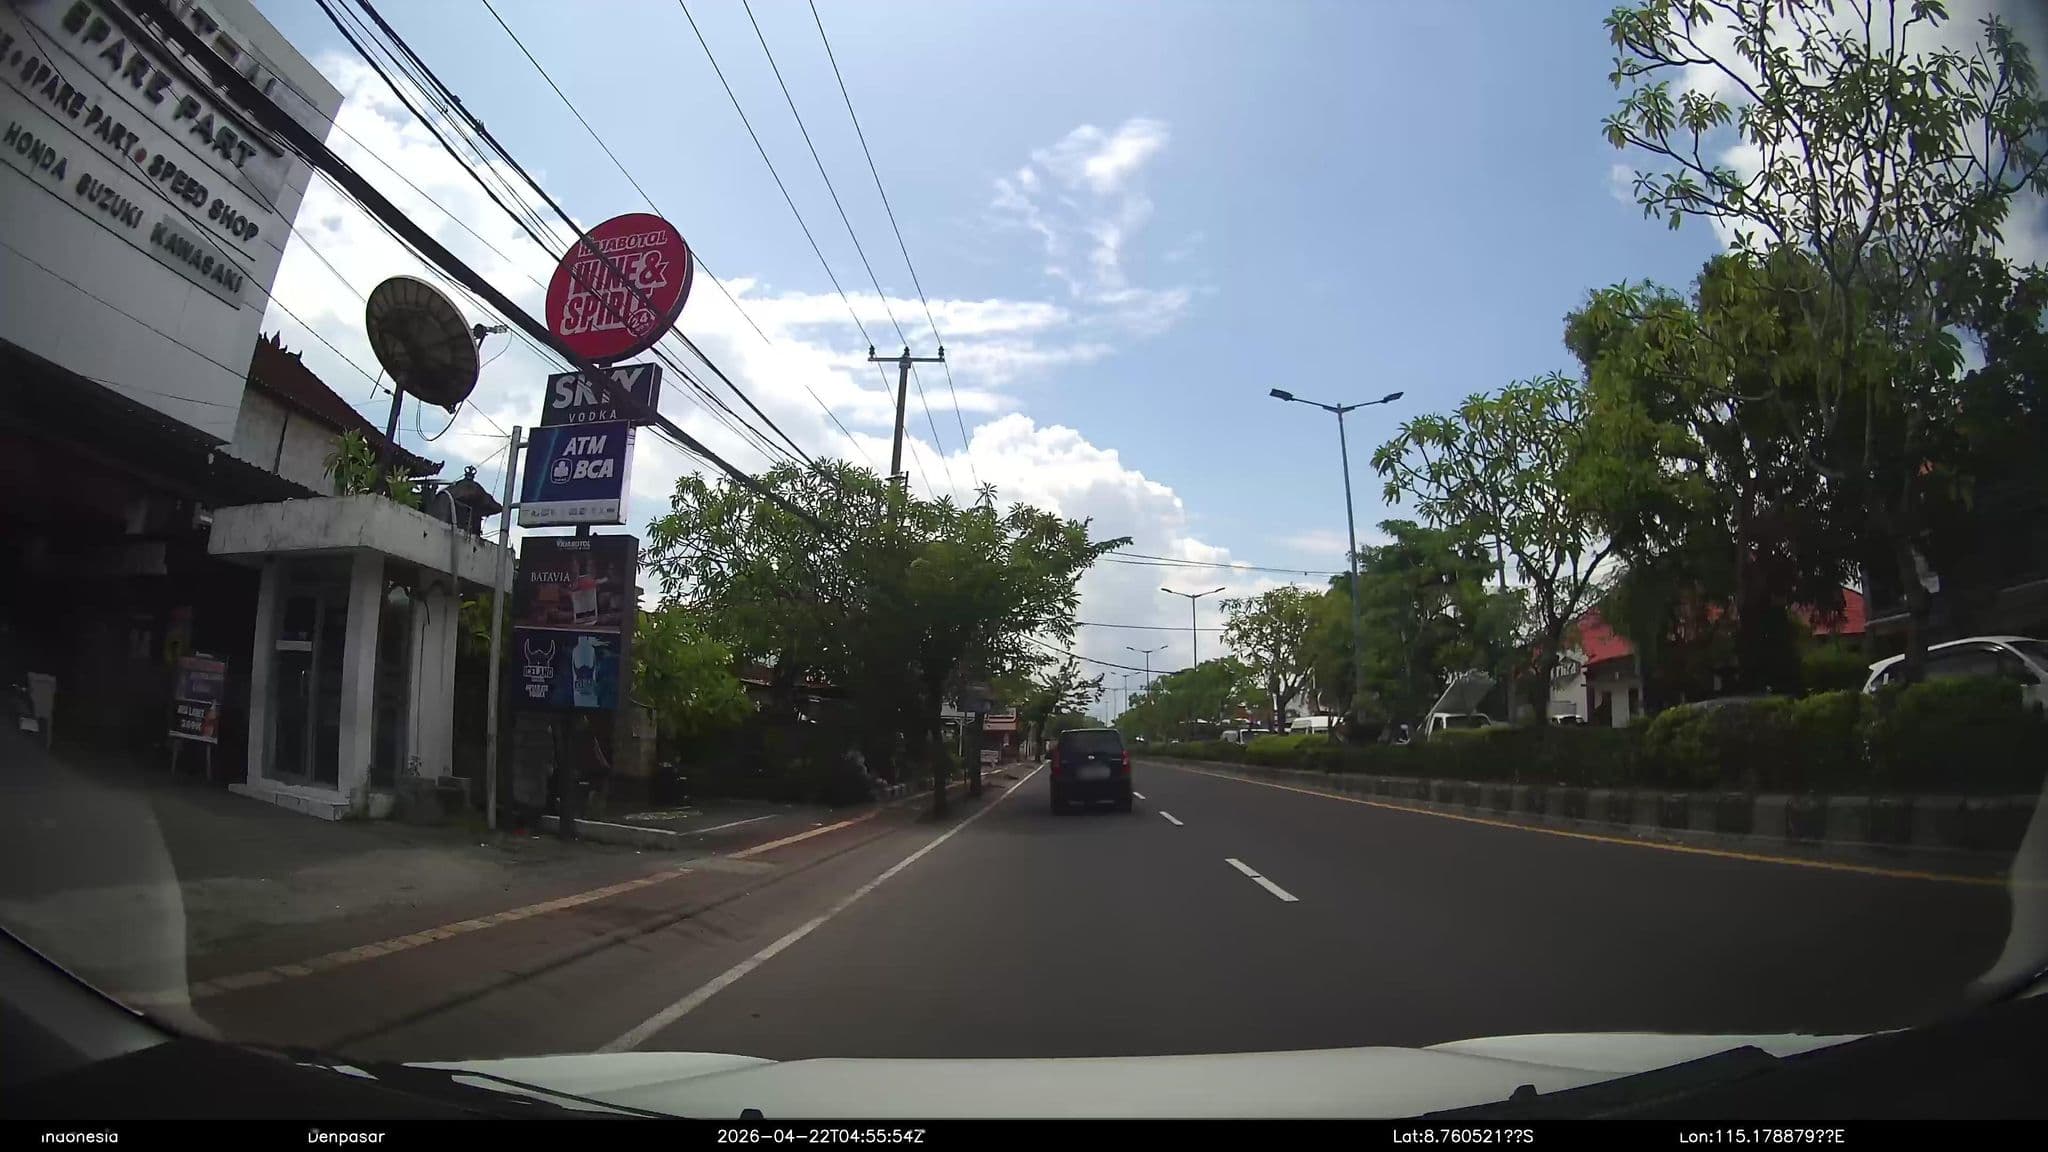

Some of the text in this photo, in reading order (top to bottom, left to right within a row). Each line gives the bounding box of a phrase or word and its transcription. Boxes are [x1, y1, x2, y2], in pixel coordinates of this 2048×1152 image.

[61, 1, 173, 105] SPARE
[173, 95, 256, 168] PART
[20, 56, 260, 242] SPARE PART SPEED SHOP
[2, 121, 244, 294] HONDA SUZUKI KAWASAKI
[567, 409, 618, 423] VODKA
[562, 434, 607, 457] ATM
[572, 458, 615, 480] BCA
[531, 571, 571, 583] BATAVIA
